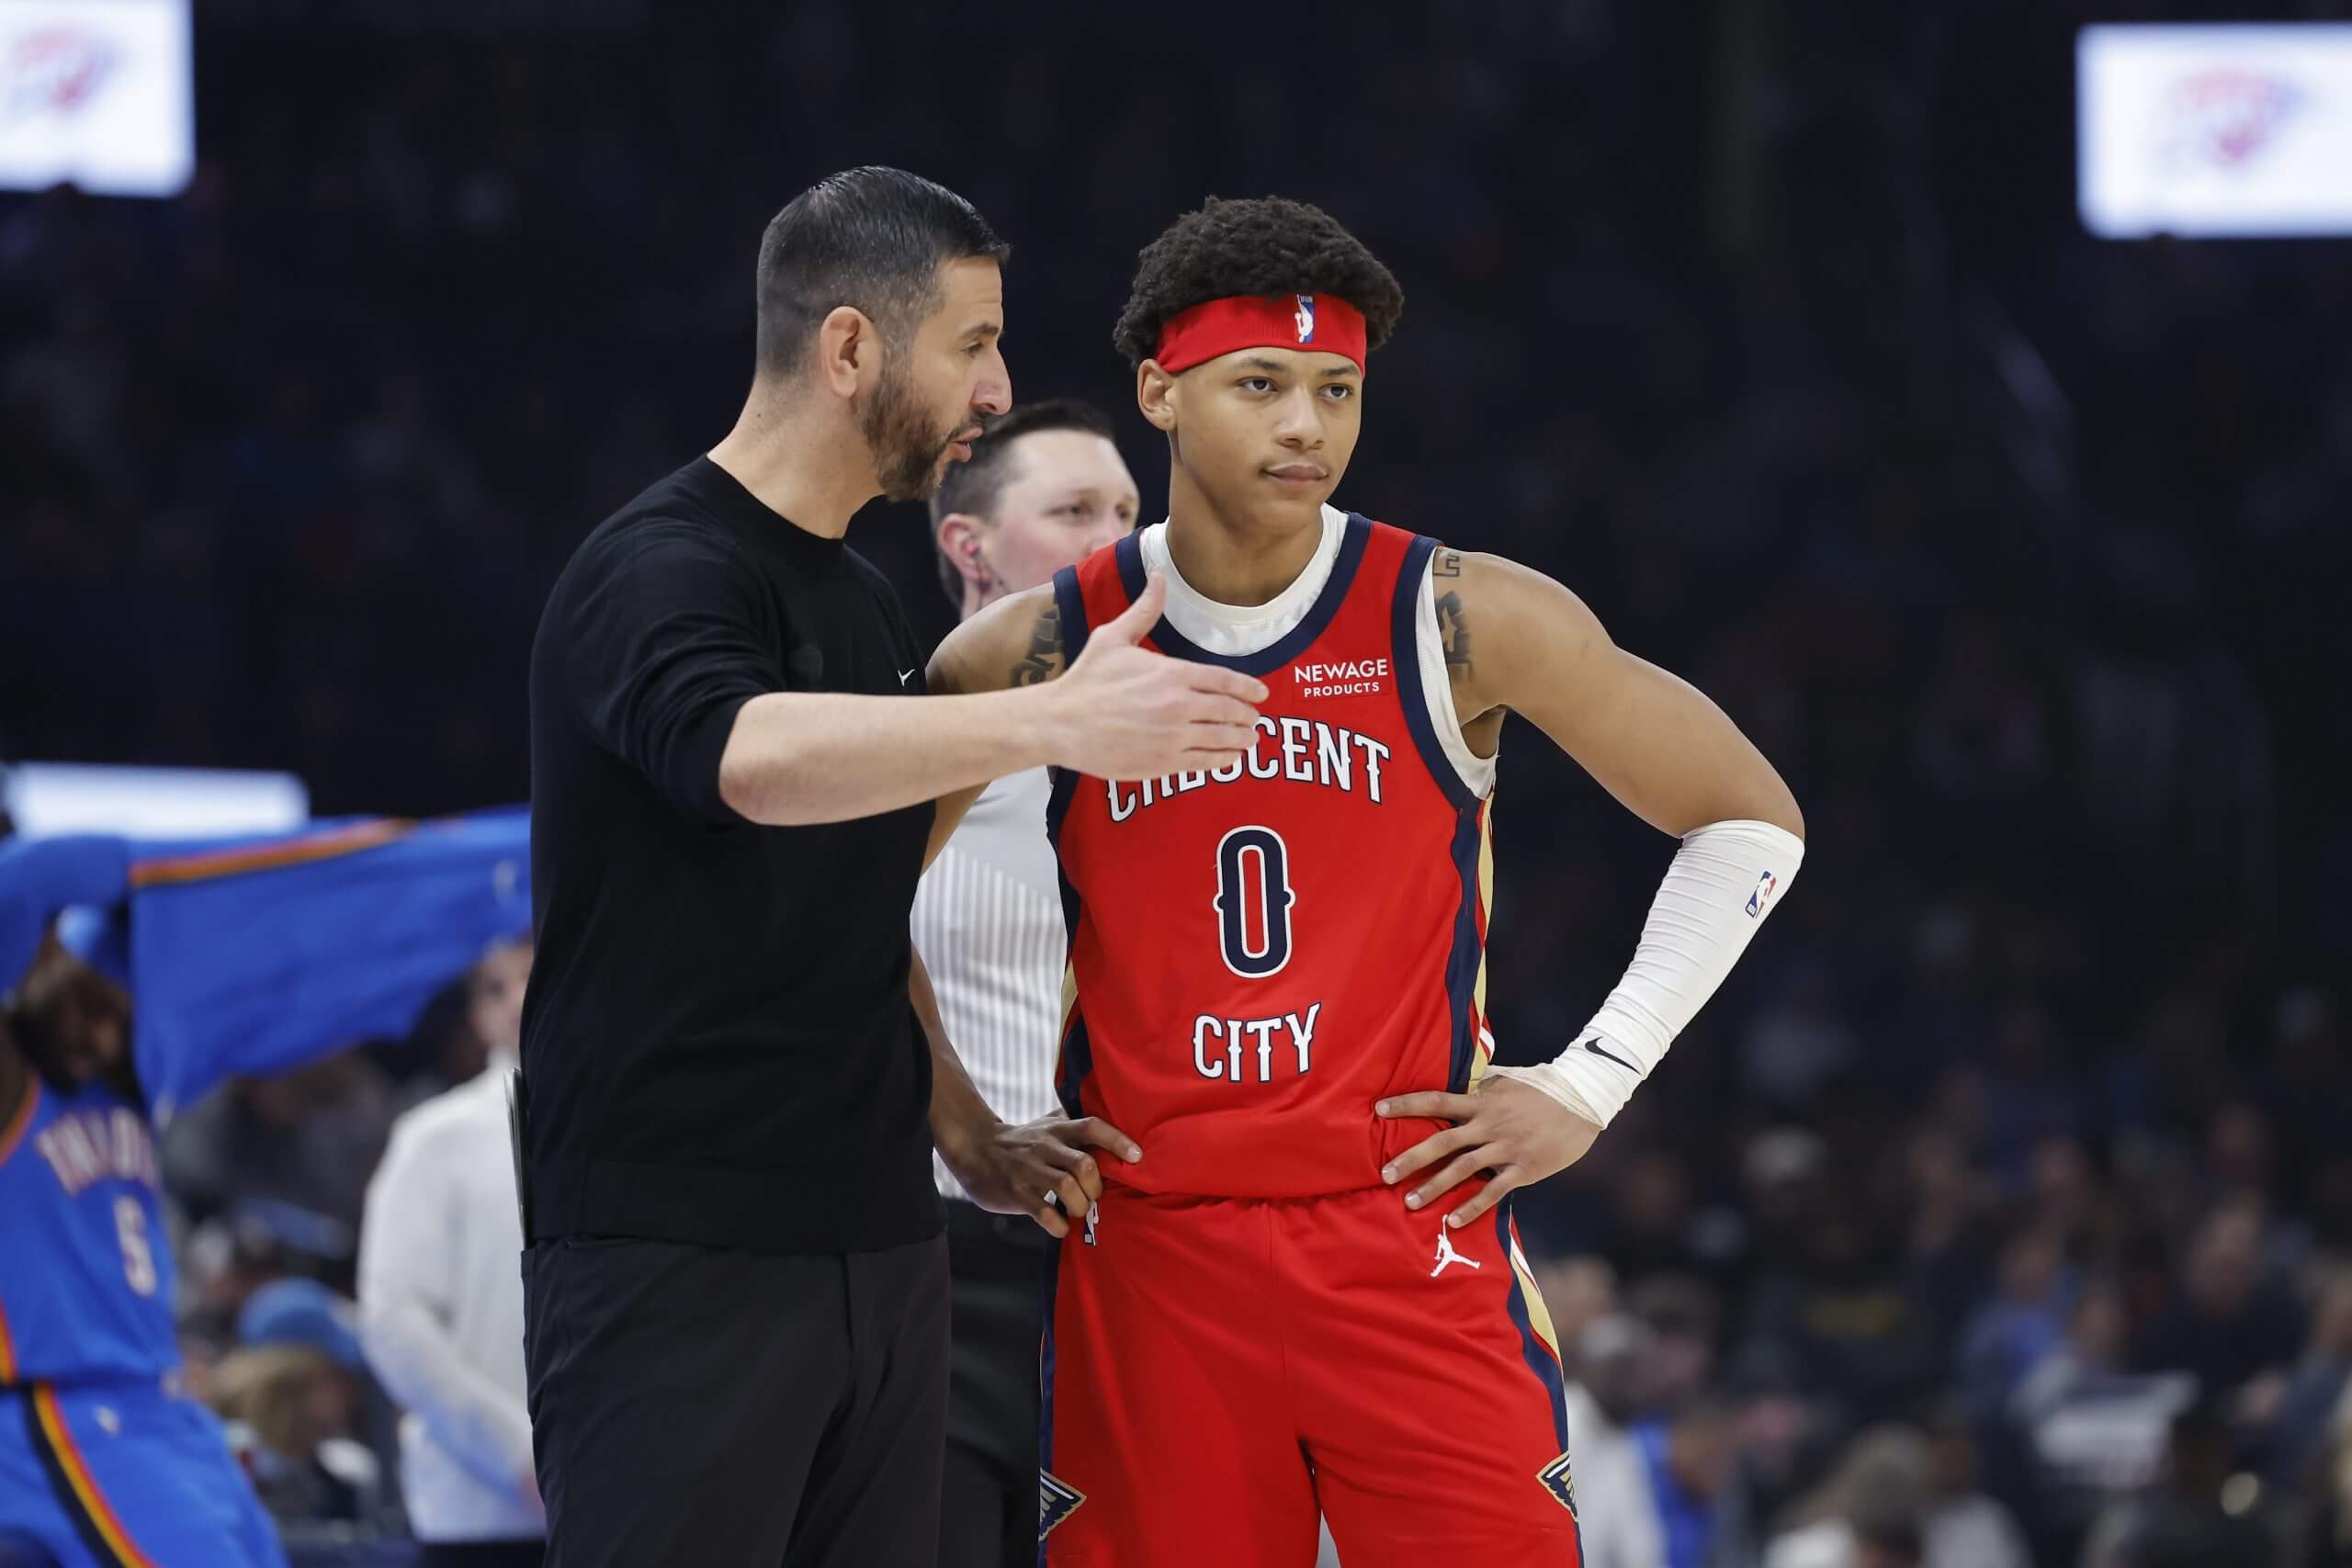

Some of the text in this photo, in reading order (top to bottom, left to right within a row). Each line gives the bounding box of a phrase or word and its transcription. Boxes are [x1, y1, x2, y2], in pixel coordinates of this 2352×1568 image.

[1295, 659, 1388, 683] NEWAGE
[1304, 682, 1380, 698] PRODUCTS
[1213, 825, 1296, 978] 0
[1193, 1002, 1321, 1082] CITY
